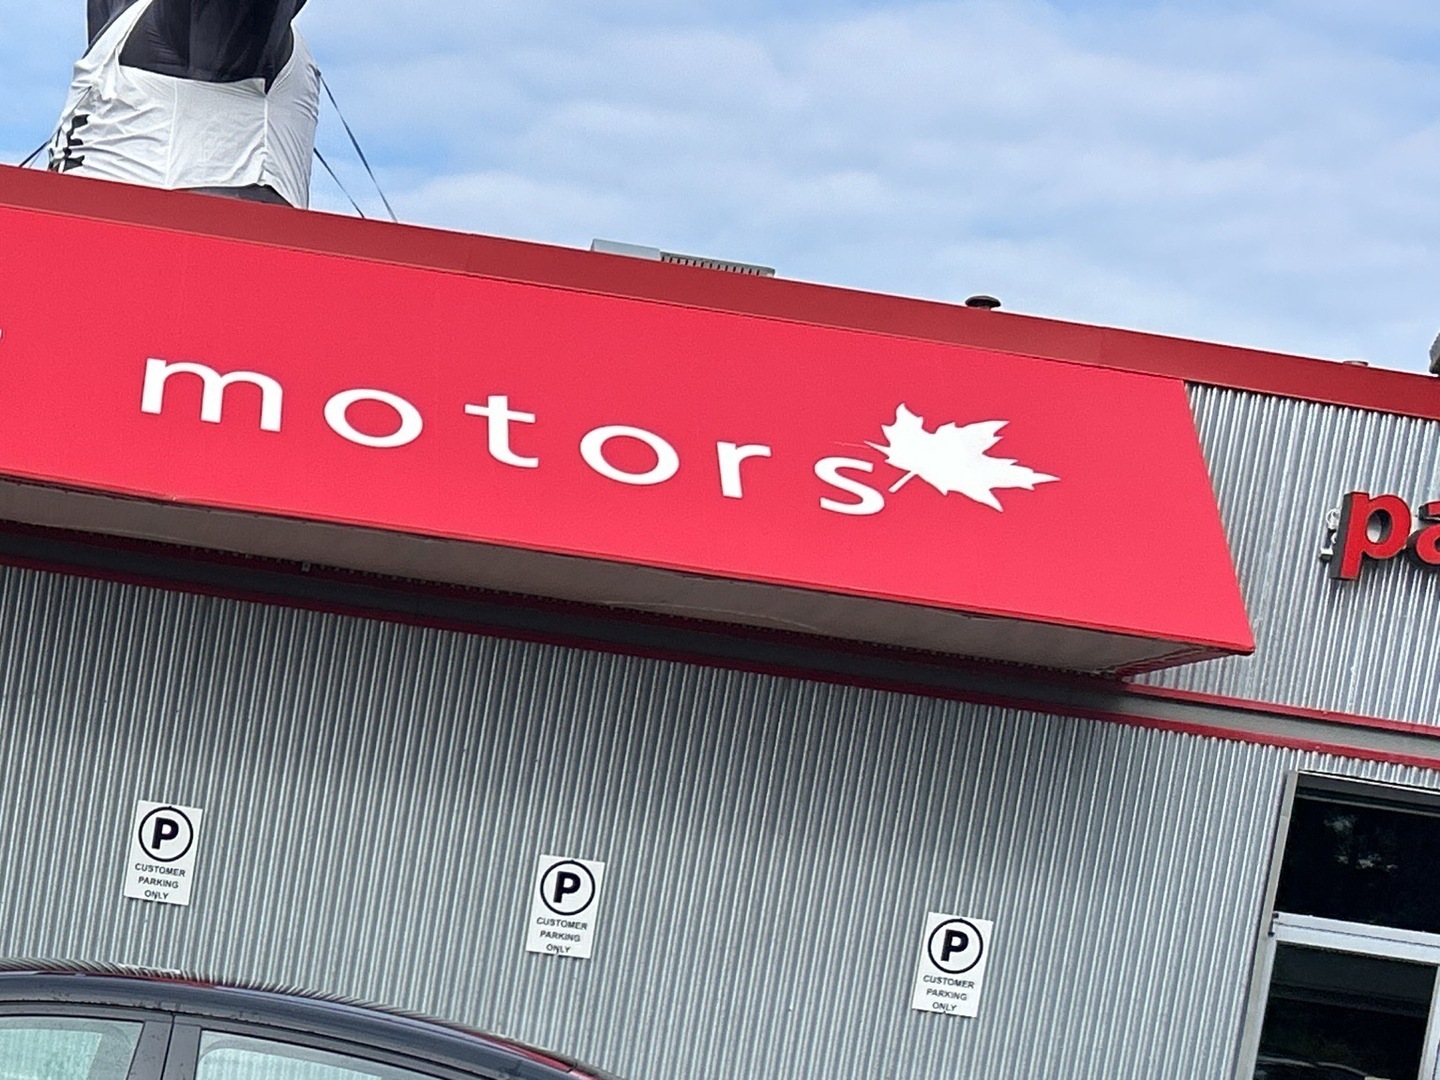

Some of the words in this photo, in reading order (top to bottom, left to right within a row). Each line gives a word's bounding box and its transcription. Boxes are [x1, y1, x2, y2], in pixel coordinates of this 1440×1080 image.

[142, 359, 884, 515] motors
[152, 817, 179, 850] P
[134, 863, 186, 877] CUSTOMER
[138, 876, 179, 889] PARKING
[553, 871, 581, 904] P
[144, 890, 169, 900] ONLY
[536, 917, 588, 930] CUSTOMER
[539, 930, 581, 942] PARKING
[546, 943, 571, 954] ONLY
[940, 929, 969, 962] P
[923, 975, 975, 989] CUSTOMER
[926, 988, 968, 1001] PARKING
[932, 1001, 957, 1011] ONLY
